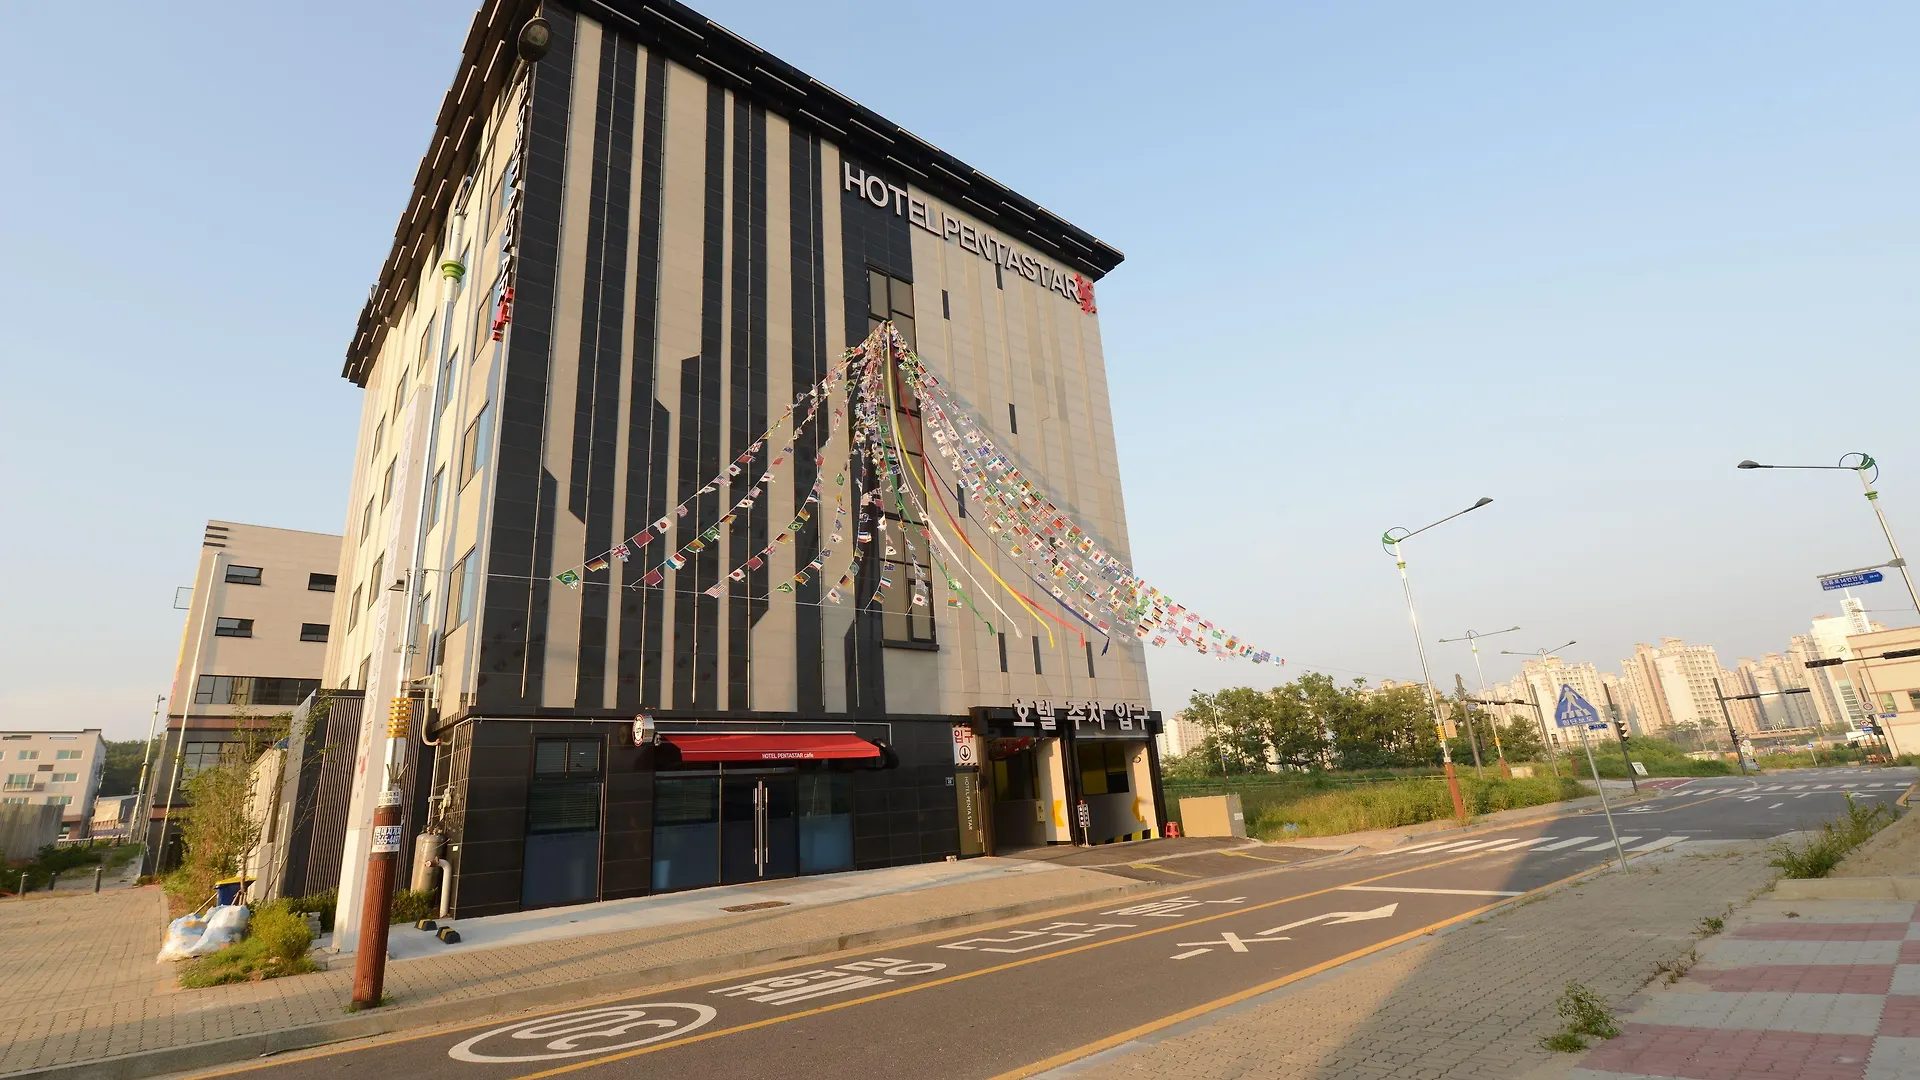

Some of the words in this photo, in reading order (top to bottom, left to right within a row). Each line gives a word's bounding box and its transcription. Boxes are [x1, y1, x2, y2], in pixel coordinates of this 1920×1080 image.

[843, 161, 941, 237] HOTEL
[942, 211, 1083, 304] PENTASTAR
[1013, 698, 1057, 731] 호텔
[1066, 700, 1106, 731] 주차
[1114, 702, 1150, 731] 입구
[953, 729, 974, 744] 입구
